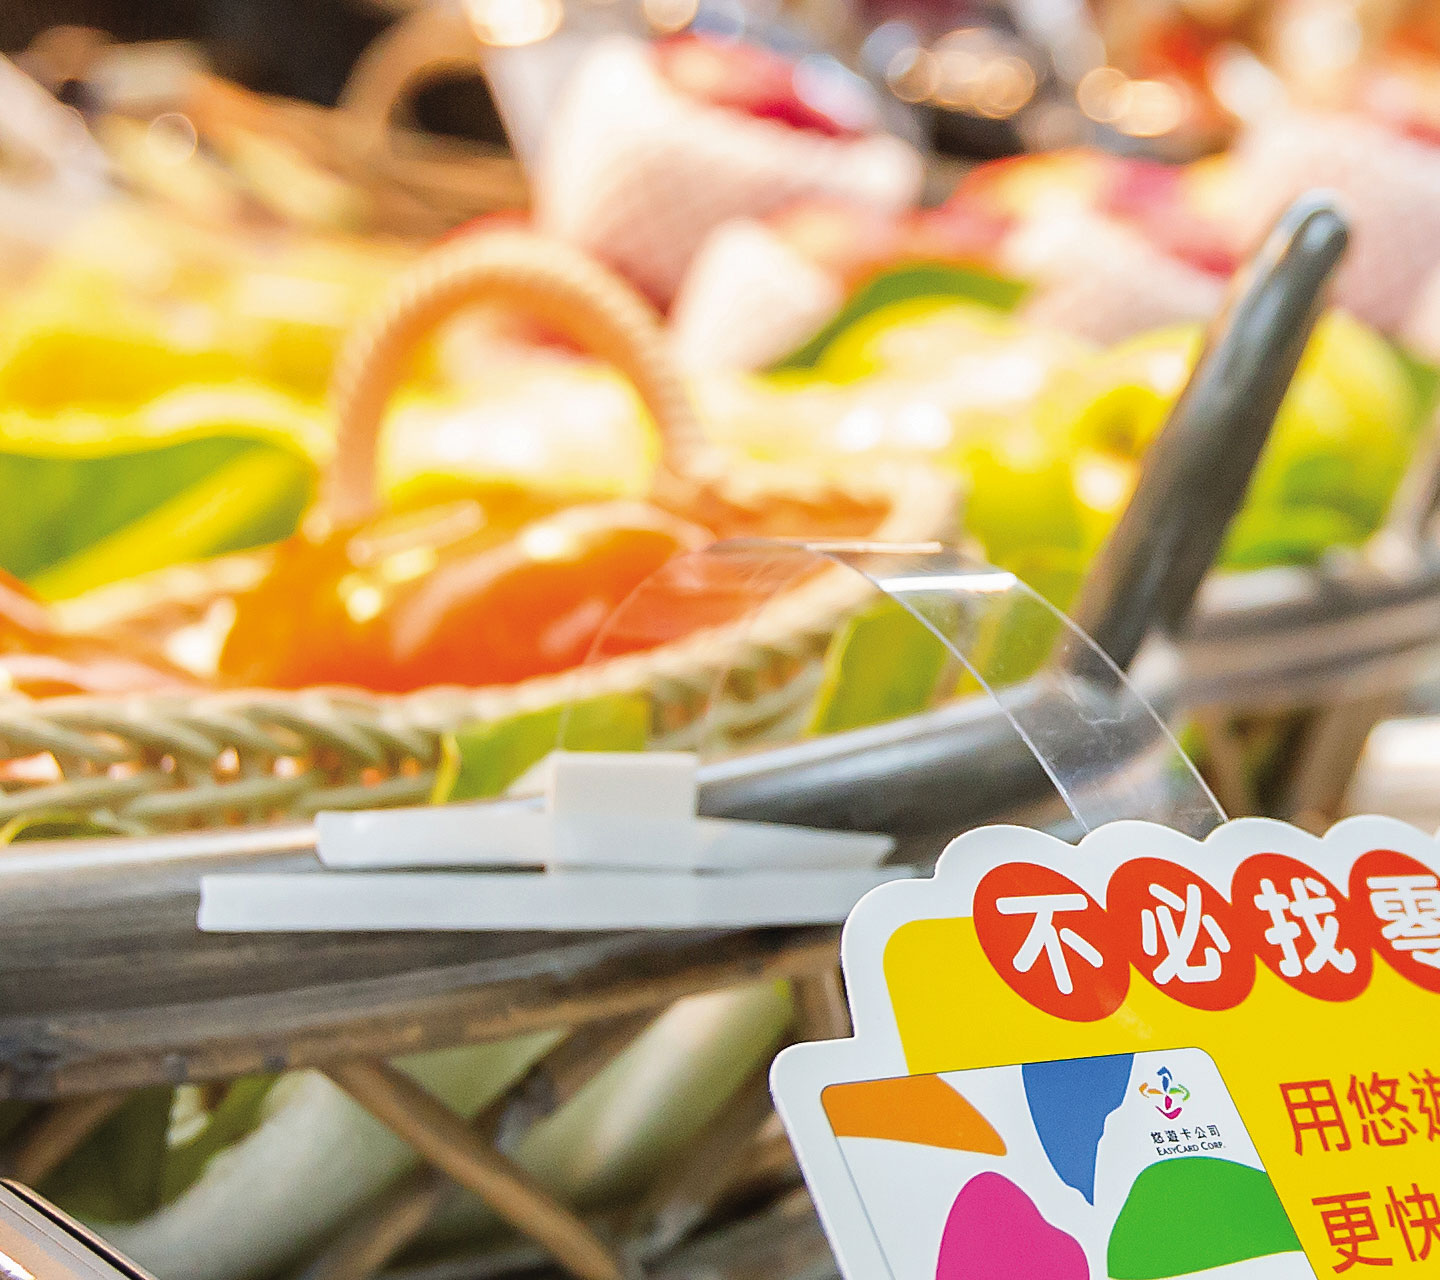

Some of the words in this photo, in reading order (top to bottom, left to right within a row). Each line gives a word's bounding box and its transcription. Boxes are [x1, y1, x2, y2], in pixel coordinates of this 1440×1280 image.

[1150, 1124, 1221, 1144] 悠遊卡公司
